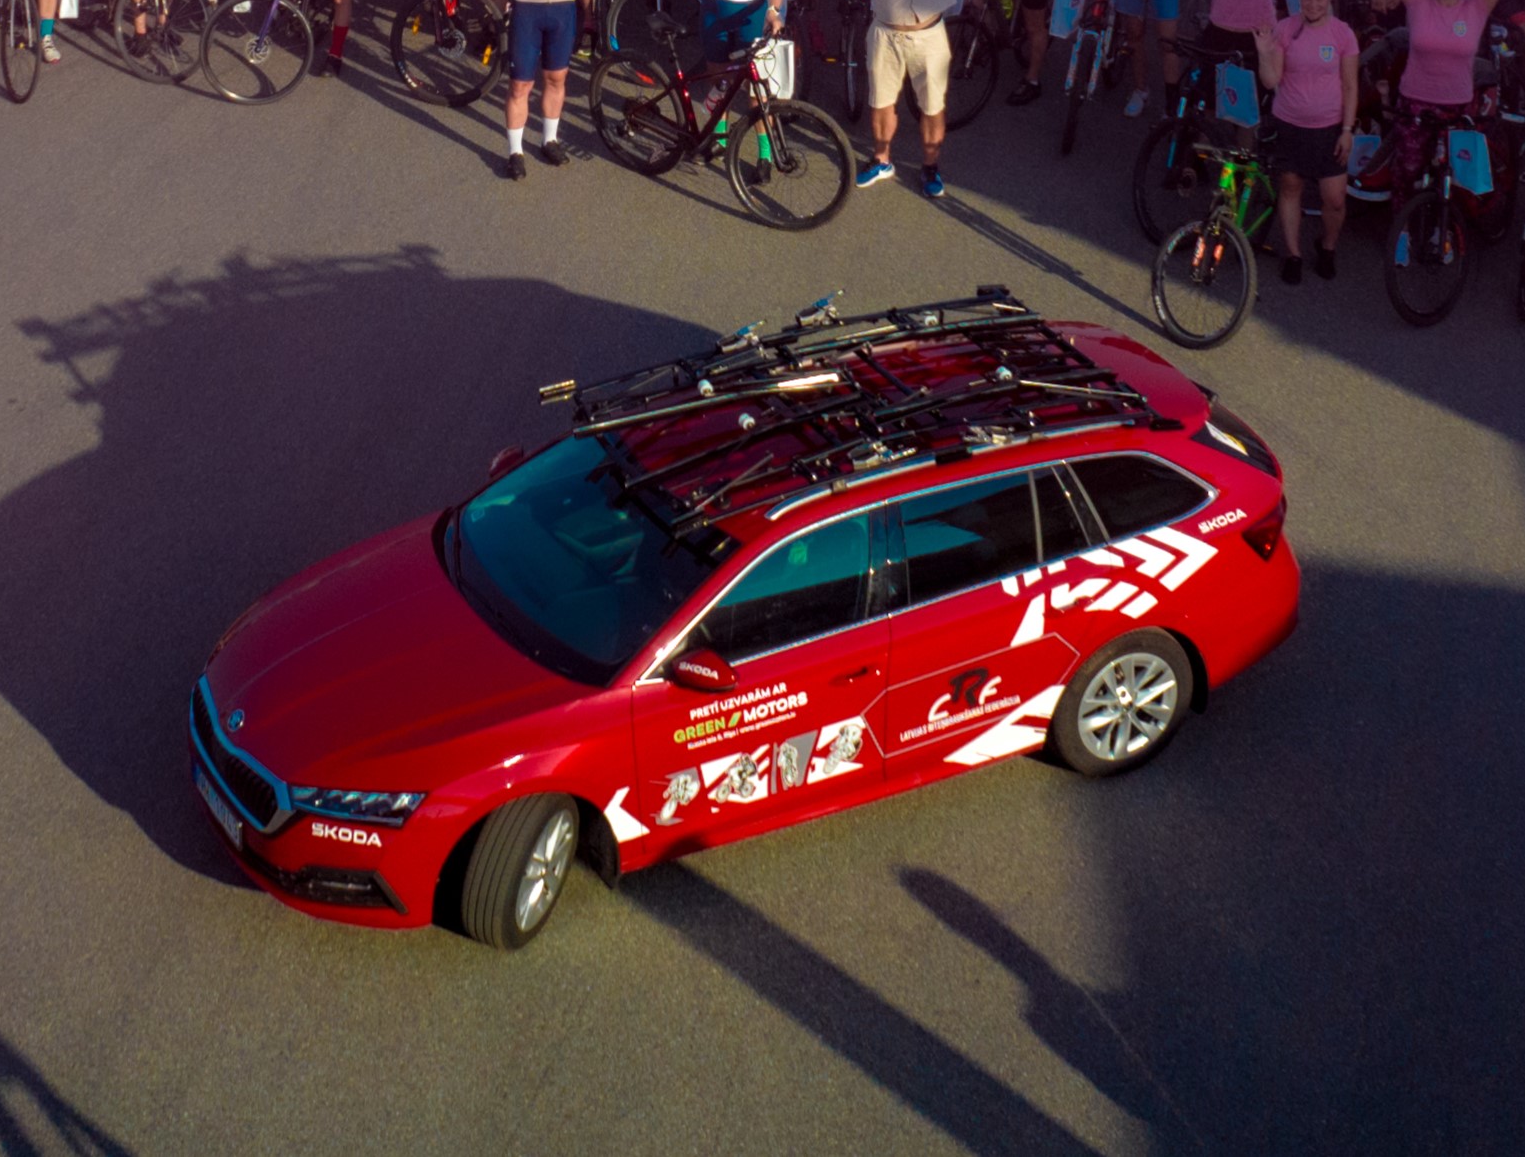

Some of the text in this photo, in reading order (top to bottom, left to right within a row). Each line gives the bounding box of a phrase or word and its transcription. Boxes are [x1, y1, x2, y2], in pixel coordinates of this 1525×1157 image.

[772, 682, 787, 696] AR
[673, 716, 726, 743] GREEN
[743, 691, 809, 723] MOTORS
